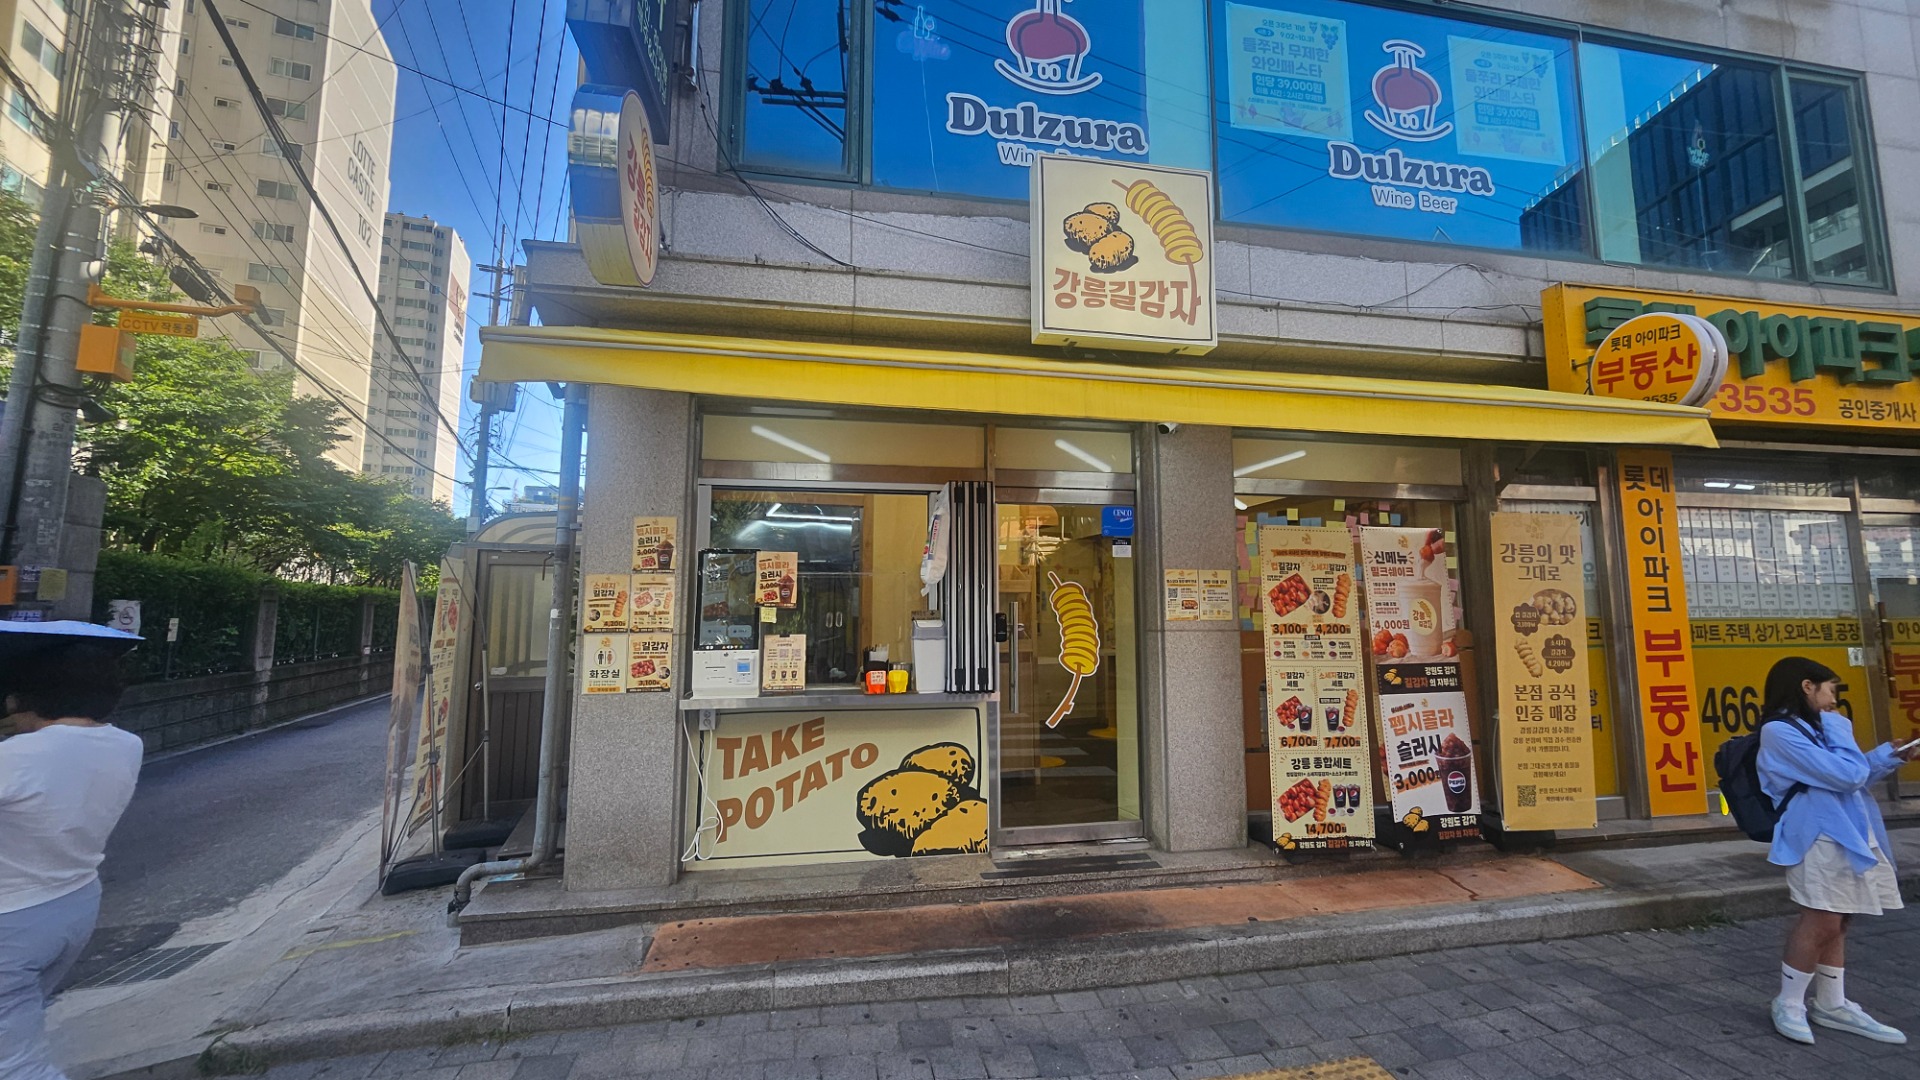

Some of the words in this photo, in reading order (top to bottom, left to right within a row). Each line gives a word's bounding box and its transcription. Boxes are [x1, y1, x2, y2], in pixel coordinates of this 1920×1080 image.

[1289, 44, 1329, 63] 무제한
[1252, 56, 1322, 78] 와인페스타
[1277, 78, 1322, 93] 39,000원
[948, 95, 1146, 152] Dulzura
[353, 132, 376, 184] LOTTE
[1329, 143, 1493, 193] Dulzura
[347, 157, 376, 213] CASTLE
[1374, 188, 1413, 207] Wine
[1422, 191, 1456, 211] Beer
[1053, 267, 1202, 326] 강릉길감자
[1611, 334, 1632, 352] 롯데
[1635, 323, 1682, 347] 아이파크
[1597, 342, 1698, 394] 부동산
[1838, 398, 1917, 422] 공인중개사
[1624, 464, 1670, 493] 롯데
[1374, 551, 1408, 565] 신메뉴
[1500, 543, 1554, 564] 강릉의
[1560, 544, 1576, 565] 맛
[1637, 497, 1673, 613] 아이파크
[760, 571, 782, 579] 슬러시
[1518, 565, 1562, 581] 그대로
[1375, 619, 1410, 630] 4,000원
[589, 669, 620, 679] 화장실
[1444, 666, 1456, 675] 감자
[1514, 684, 1543, 701] 본점
[1548, 684, 1576, 701] 공식
[1515, 705, 1545, 722] 인증
[1549, 704, 1578, 722] 매장
[1644, 628, 1699, 793] 부동산
[1388, 708, 1455, 736] 펩시콜라
[716, 716, 825, 780] TAKE
[1281, 736, 1318, 748] 6,700원
[1324, 736, 1361, 748] 7,700원
[1397, 734, 1443, 762] 슬러시
[1290, 757, 1311, 770] 강릉
[1313, 756, 1352, 769] 종합세트
[716, 742, 879, 844] POTATO
[1304, 823, 1347, 835] 14,700원
